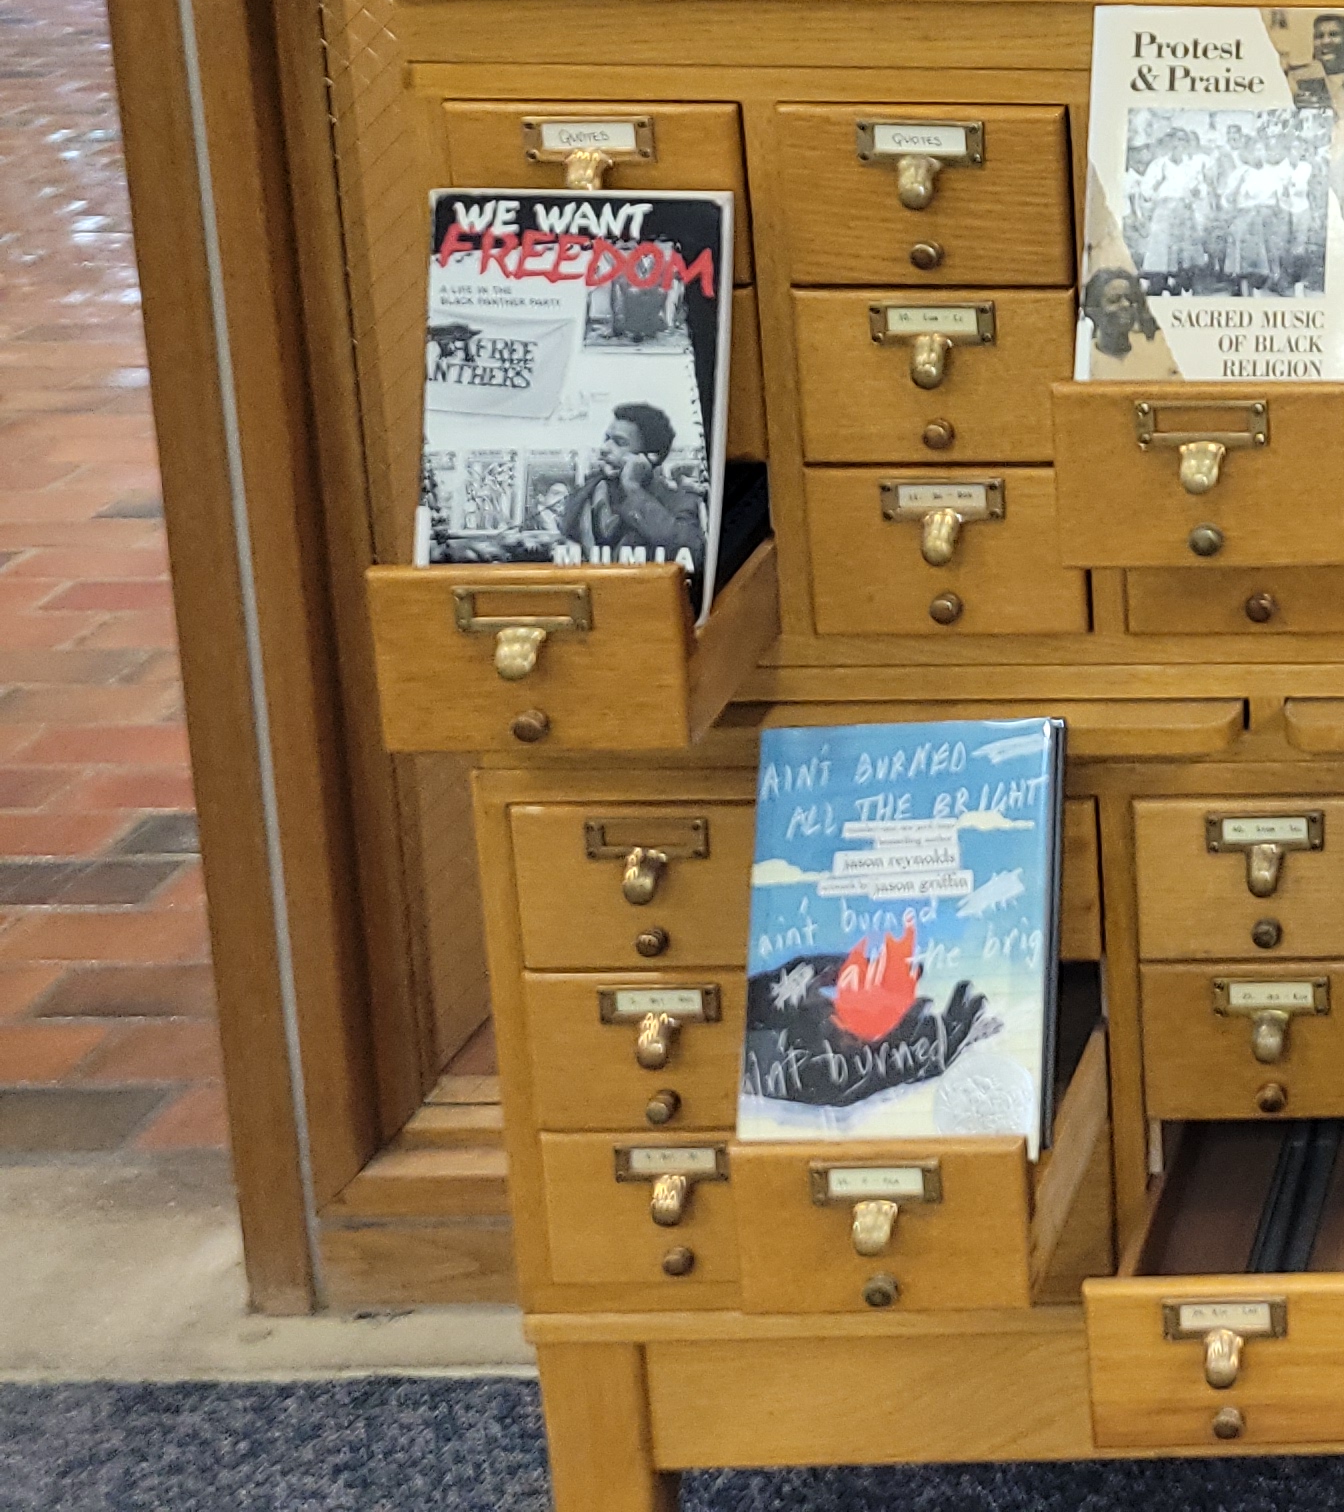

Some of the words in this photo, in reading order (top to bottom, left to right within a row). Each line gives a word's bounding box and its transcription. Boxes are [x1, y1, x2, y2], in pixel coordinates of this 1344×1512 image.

[1132, 30, 1243, 61] Protest
[1130, 64, 1160, 93] &
[1166, 64, 1265, 94] Praise
[453, 200, 520, 234] WE
[534, 202, 653, 238] WANT
[436, 223, 717, 299] FREEDOM
[1171, 309, 1253, 329] SACRED
[1260, 310, 1324, 329] MUSIC
[1218, 334, 1245, 353] OF
[1254, 334, 1324, 353] BLACK
[1222, 358, 1323, 378] RELIGION
[856, 741, 968, 784] BURNED
[786, 802, 847, 840] ALL
[854, 792, 912, 822] THE
[933, 774, 1048, 820] BRIGHT
[844, 854, 884, 871] jason
[888, 848, 955, 869] reynolds
[840, 896, 937, 934] burned
[905, 938, 960, 975] the
[984, 916, 1041, 967] brig
